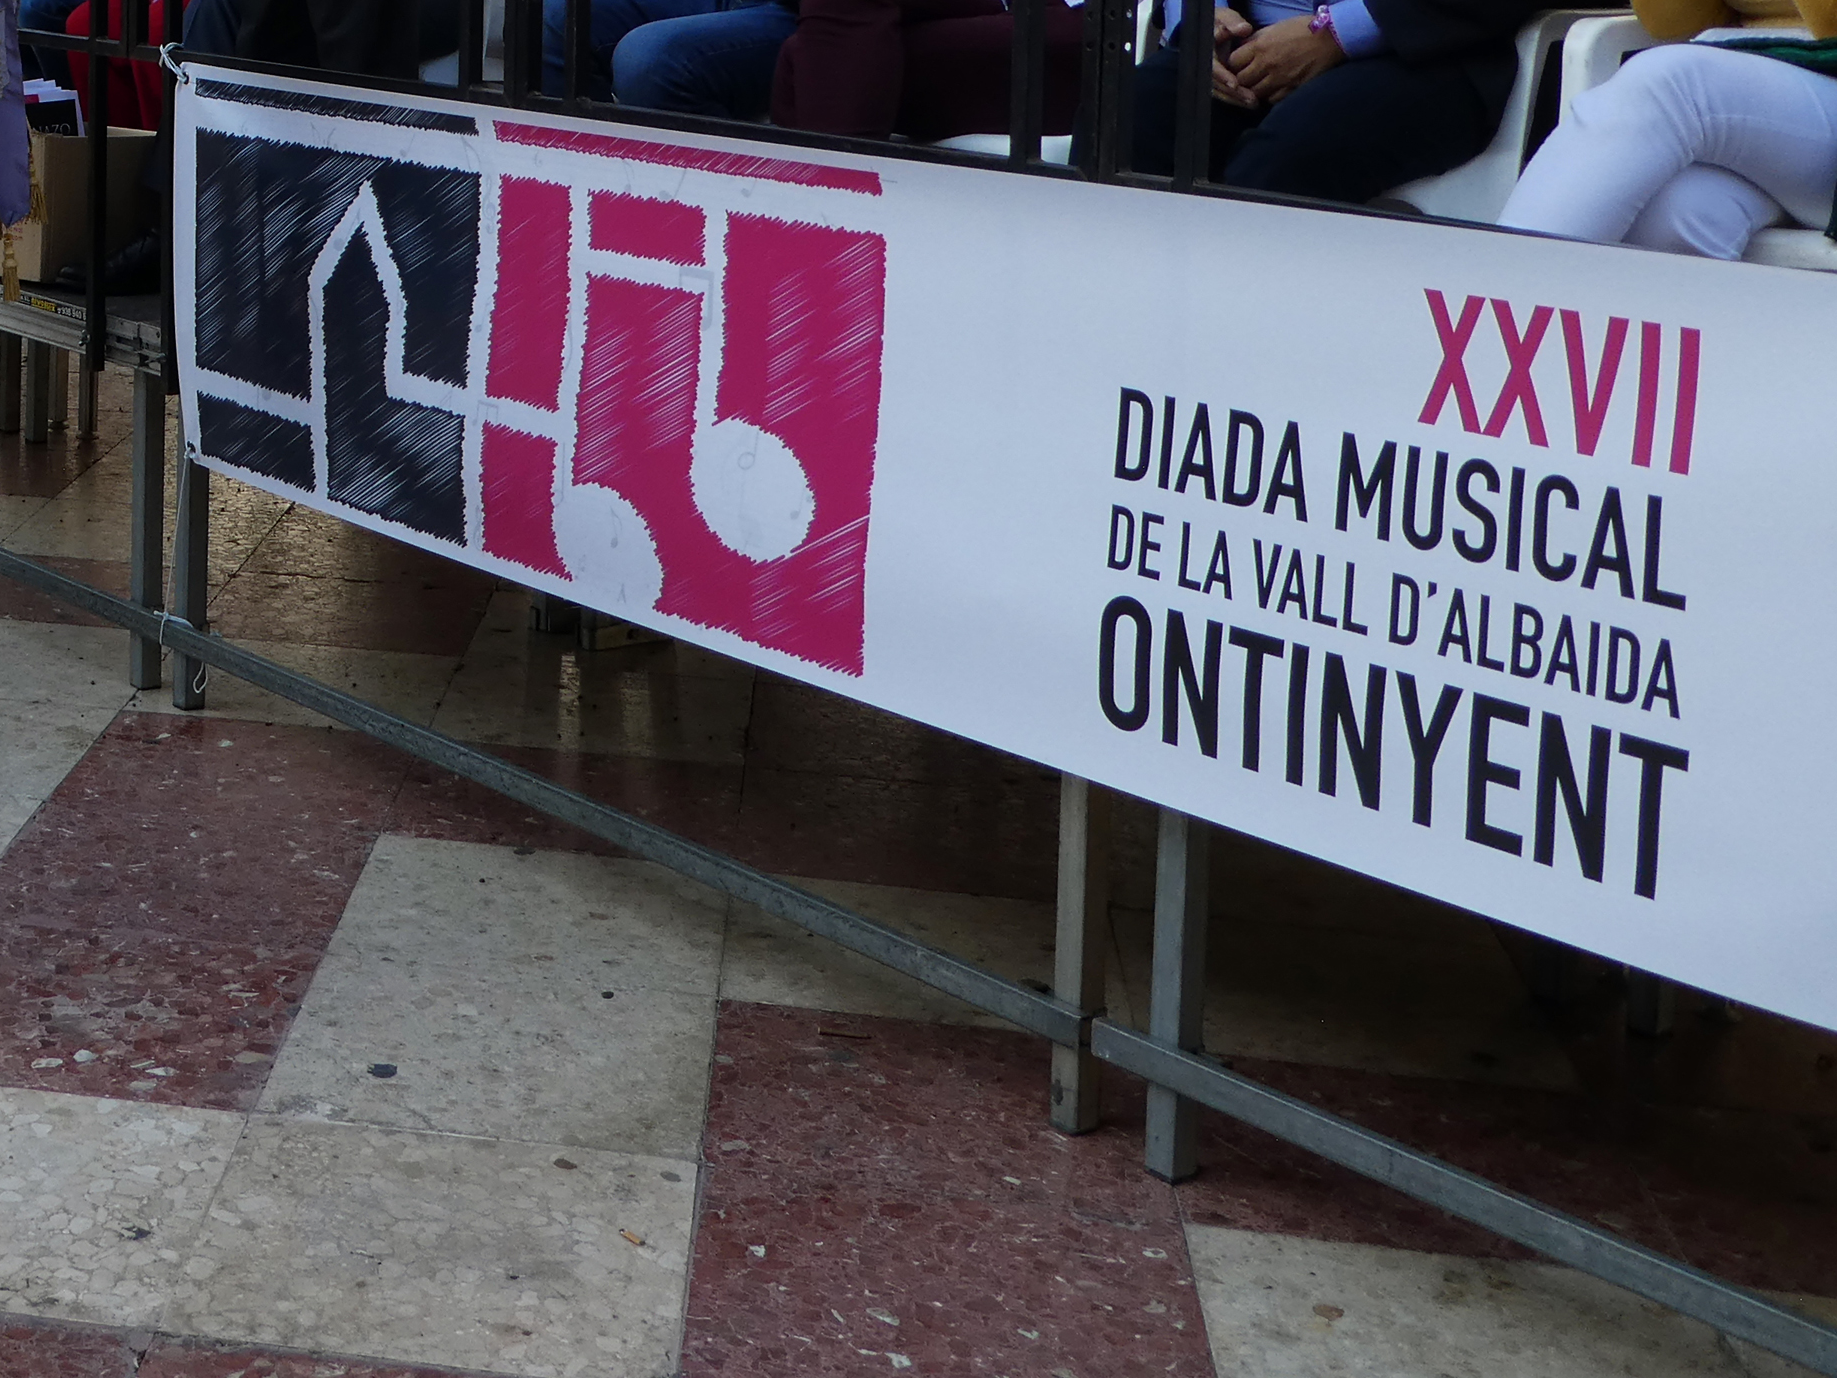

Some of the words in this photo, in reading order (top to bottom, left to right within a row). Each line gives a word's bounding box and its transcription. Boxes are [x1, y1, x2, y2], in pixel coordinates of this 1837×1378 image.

[1416, 287, 1702, 476] XXVII
[1113, 385, 1309, 523] DIADA
[1334, 430, 1688, 612] MUSICAL
[1106, 503, 1165, 582] DE
[1177, 520, 1233, 601] LA
[1253, 537, 1369, 636] VALL
[1387, 572, 1681, 720] D'ALBAIDA
[1097, 594, 1691, 902] ONTINYENT
